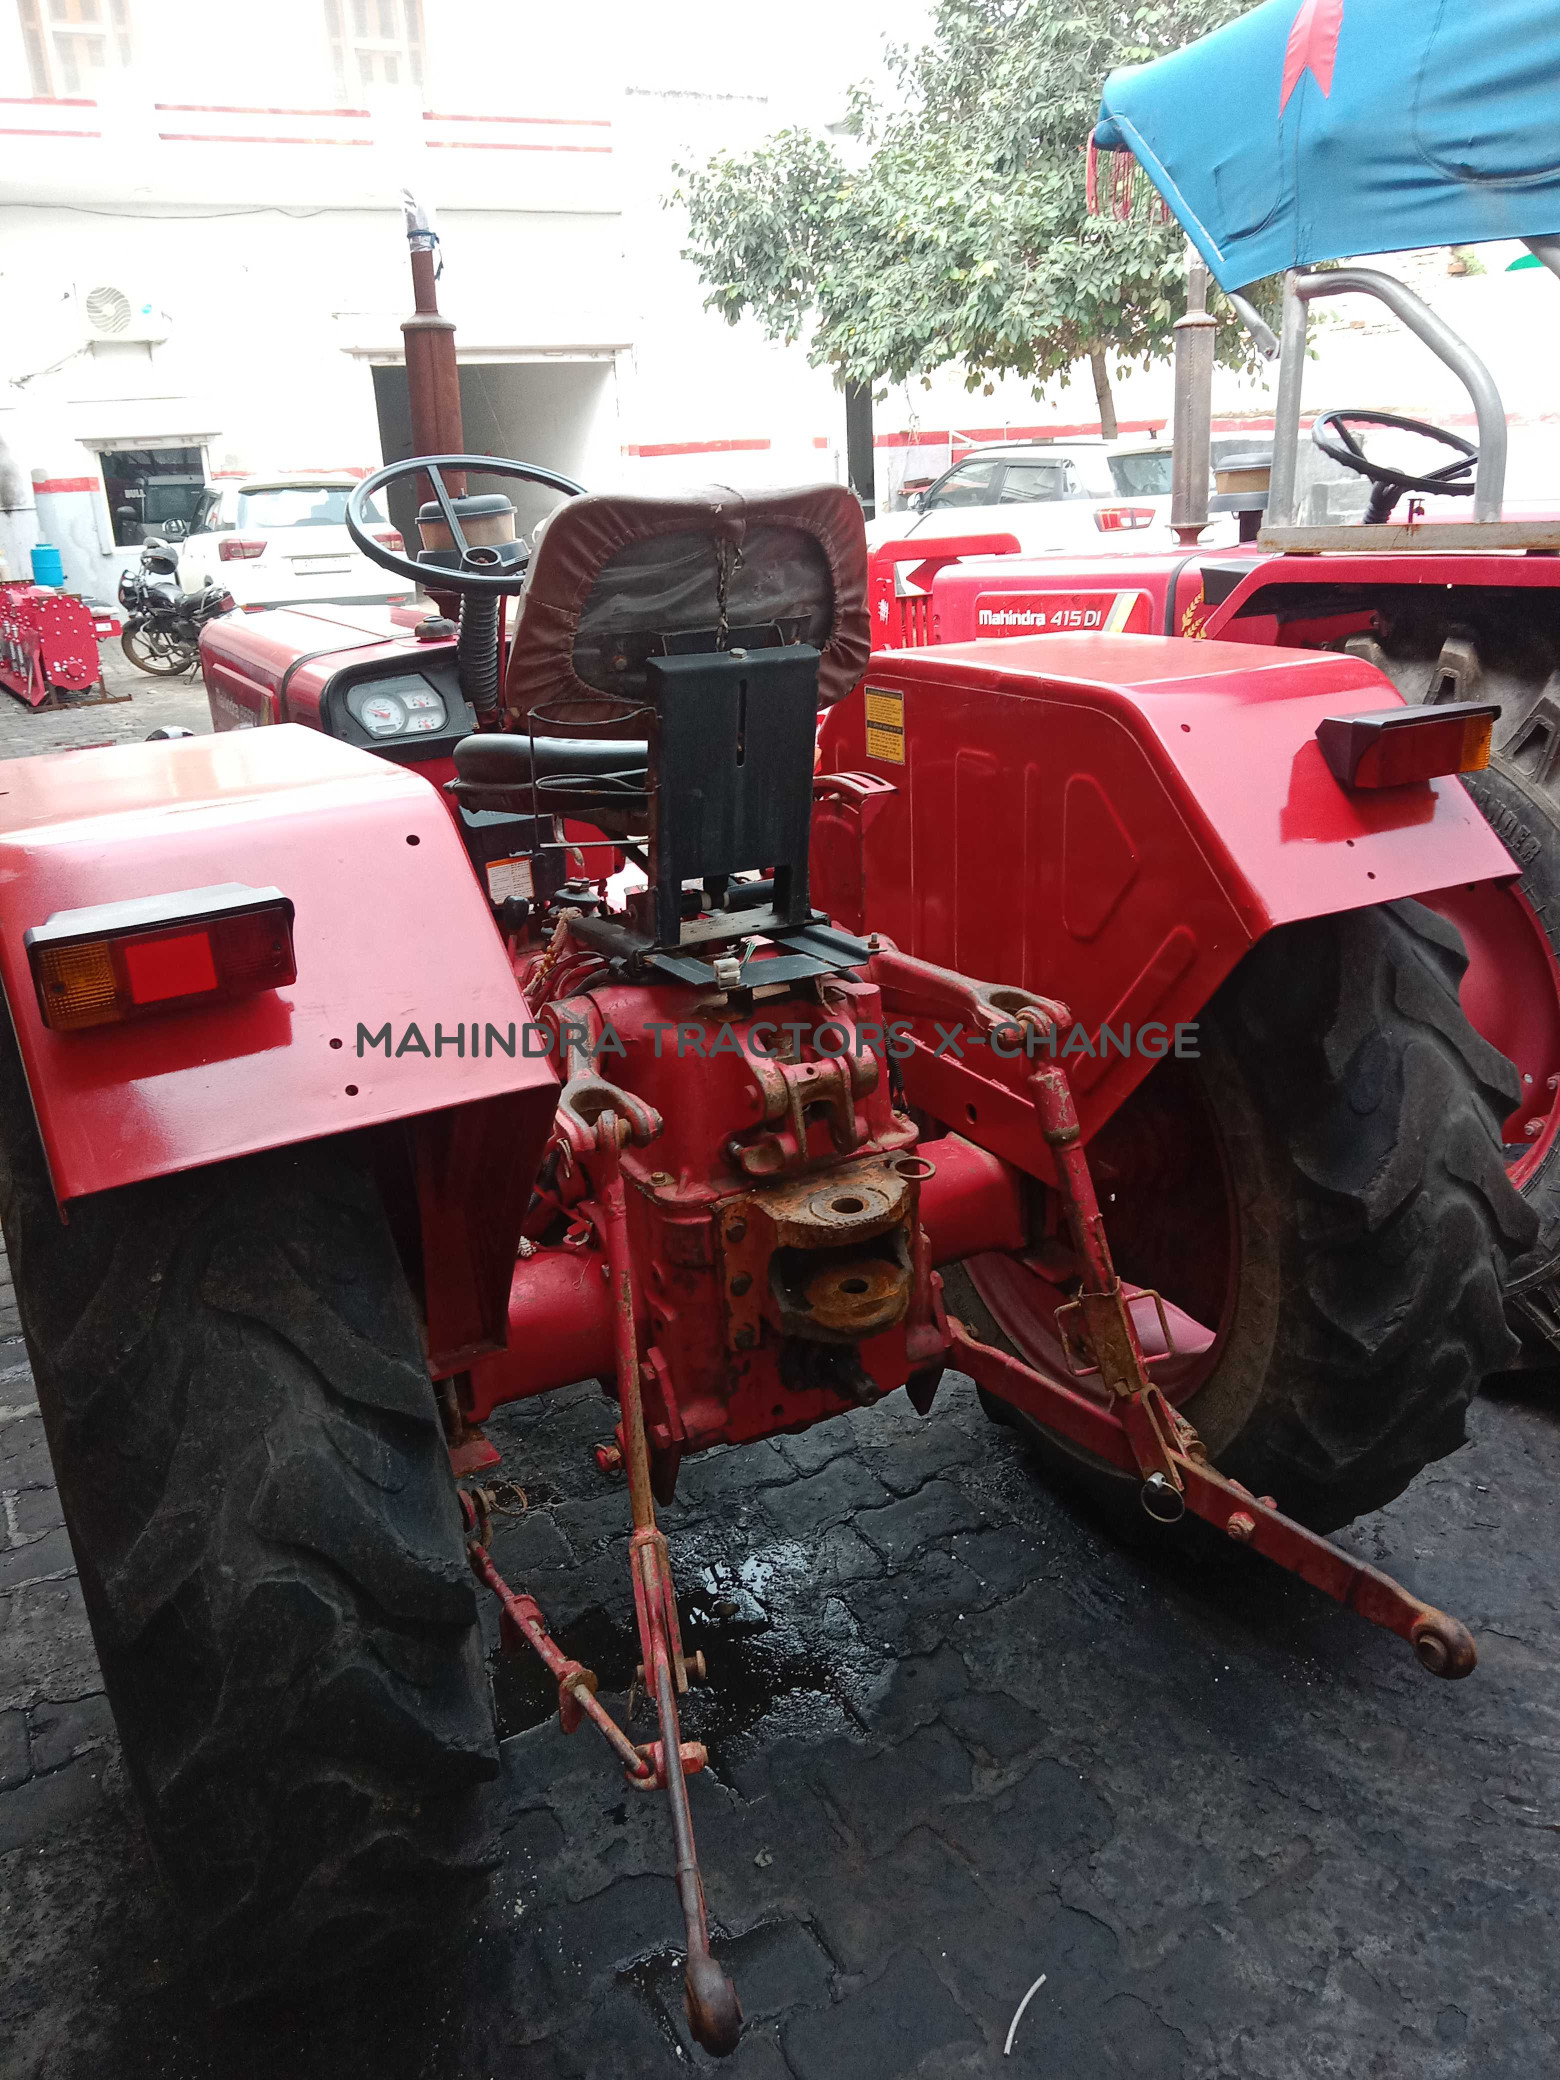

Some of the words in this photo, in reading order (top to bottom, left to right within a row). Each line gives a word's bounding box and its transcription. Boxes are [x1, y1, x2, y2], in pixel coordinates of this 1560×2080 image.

[978, 609, 1046, 627] Mahindra
[1050, 610, 1082, 627] 415
[1083, 610, 1102, 627] DI
